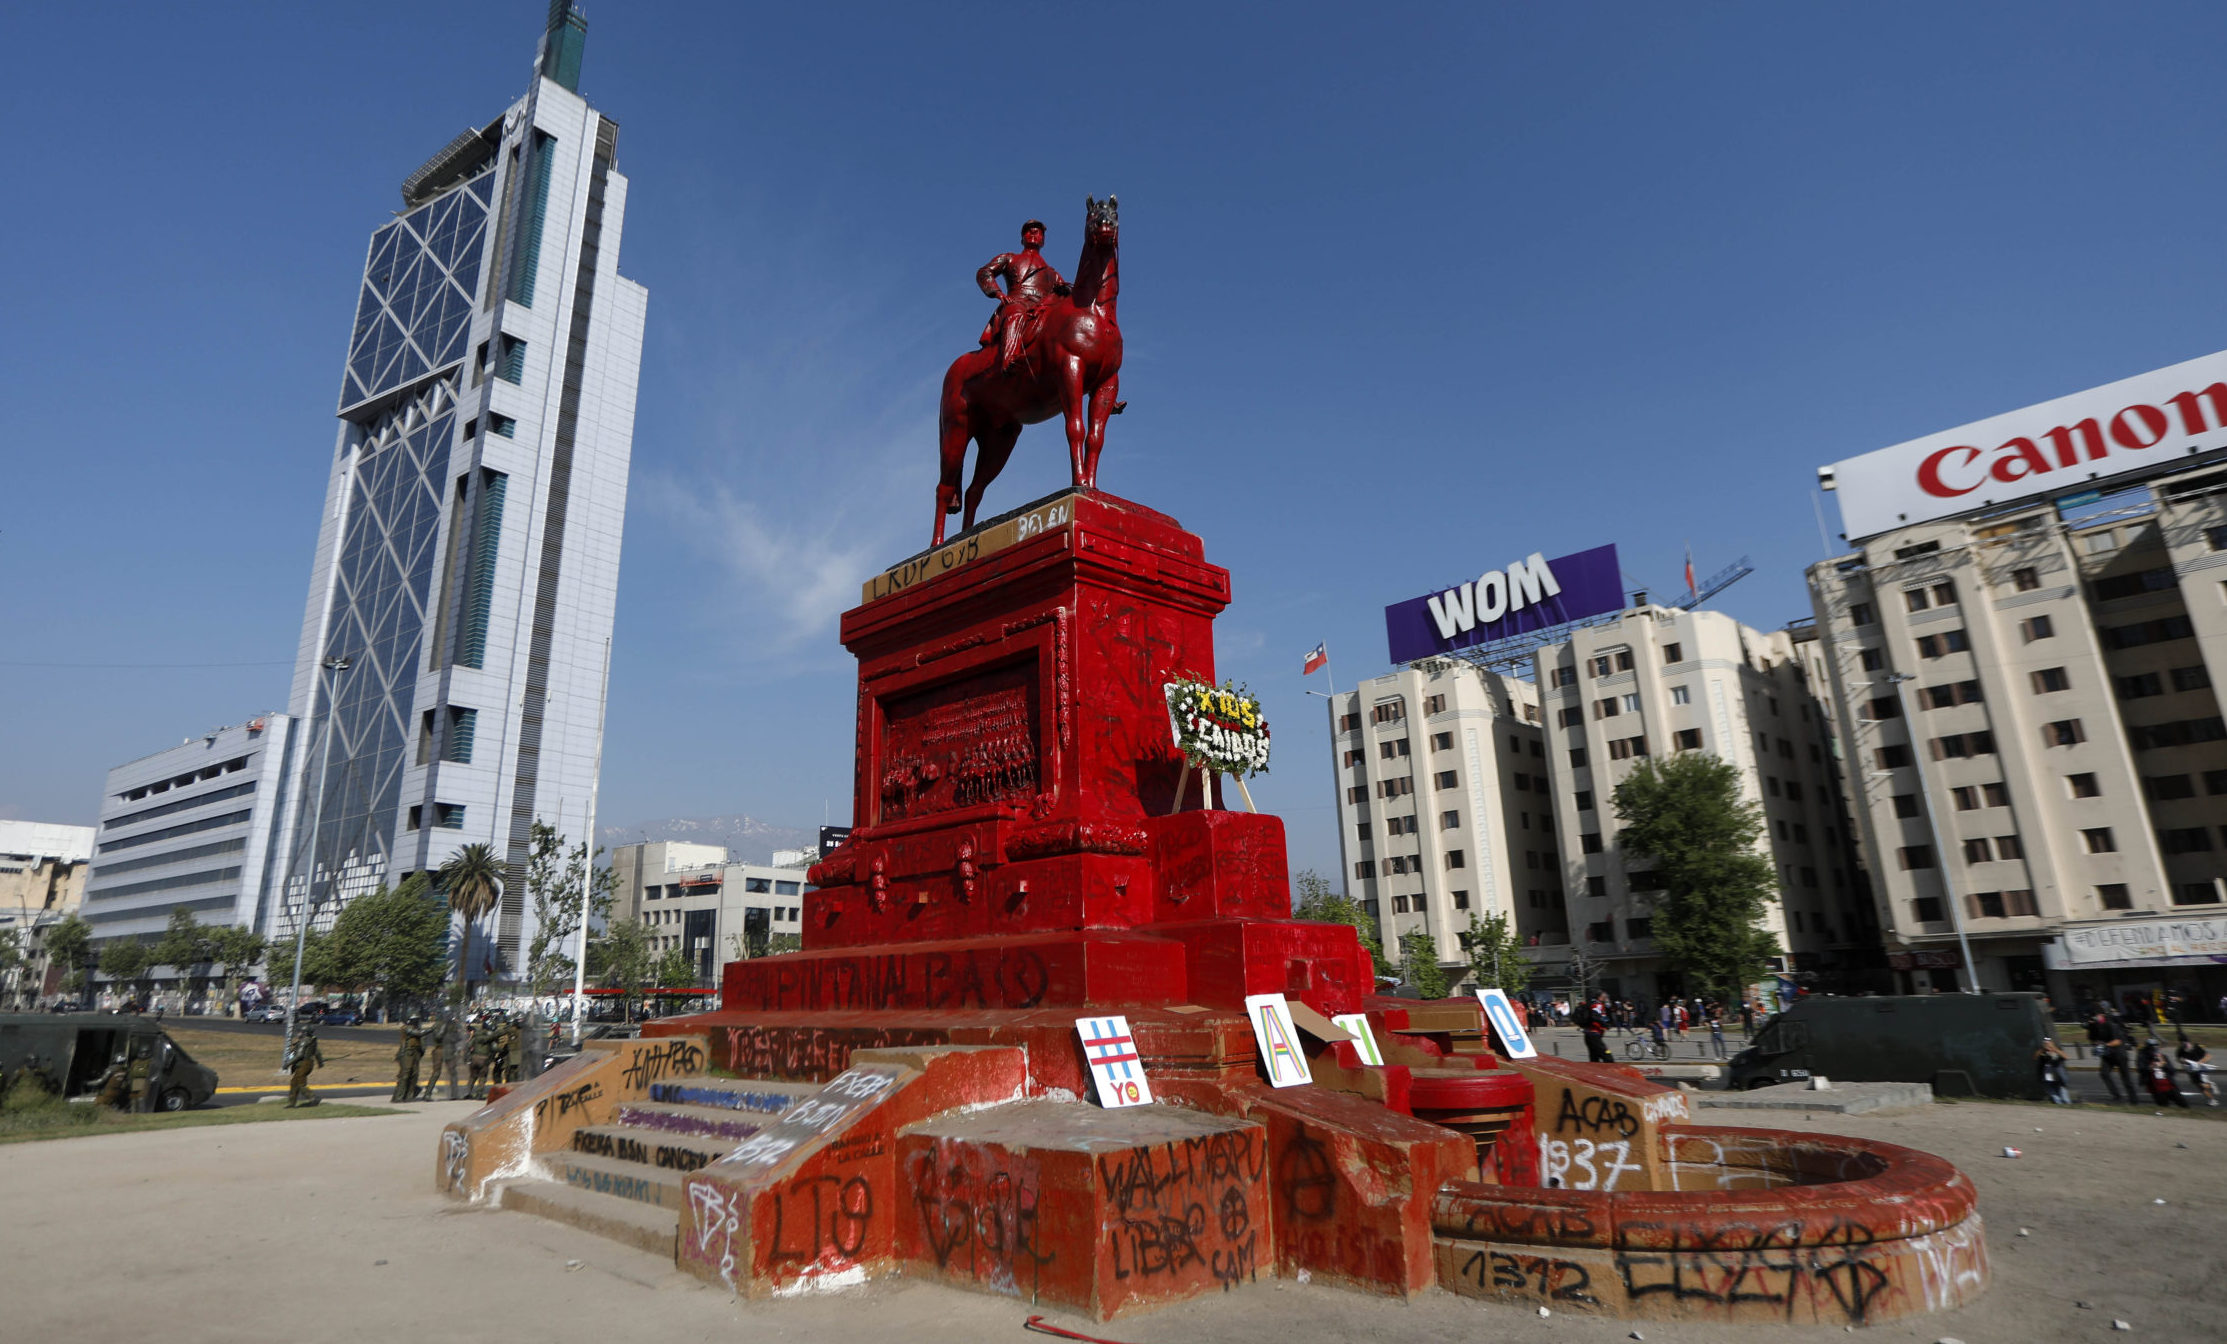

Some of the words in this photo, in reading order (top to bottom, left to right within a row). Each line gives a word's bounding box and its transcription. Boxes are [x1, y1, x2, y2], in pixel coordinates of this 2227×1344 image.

[1916, 381, 2227, 498] Canon
[1427, 551, 1562, 640] WOM
[1260, 1004, 1306, 1082] A
[1557, 1087, 1639, 1138] ACAB
[1461, 1249, 1599, 1306] 1312
